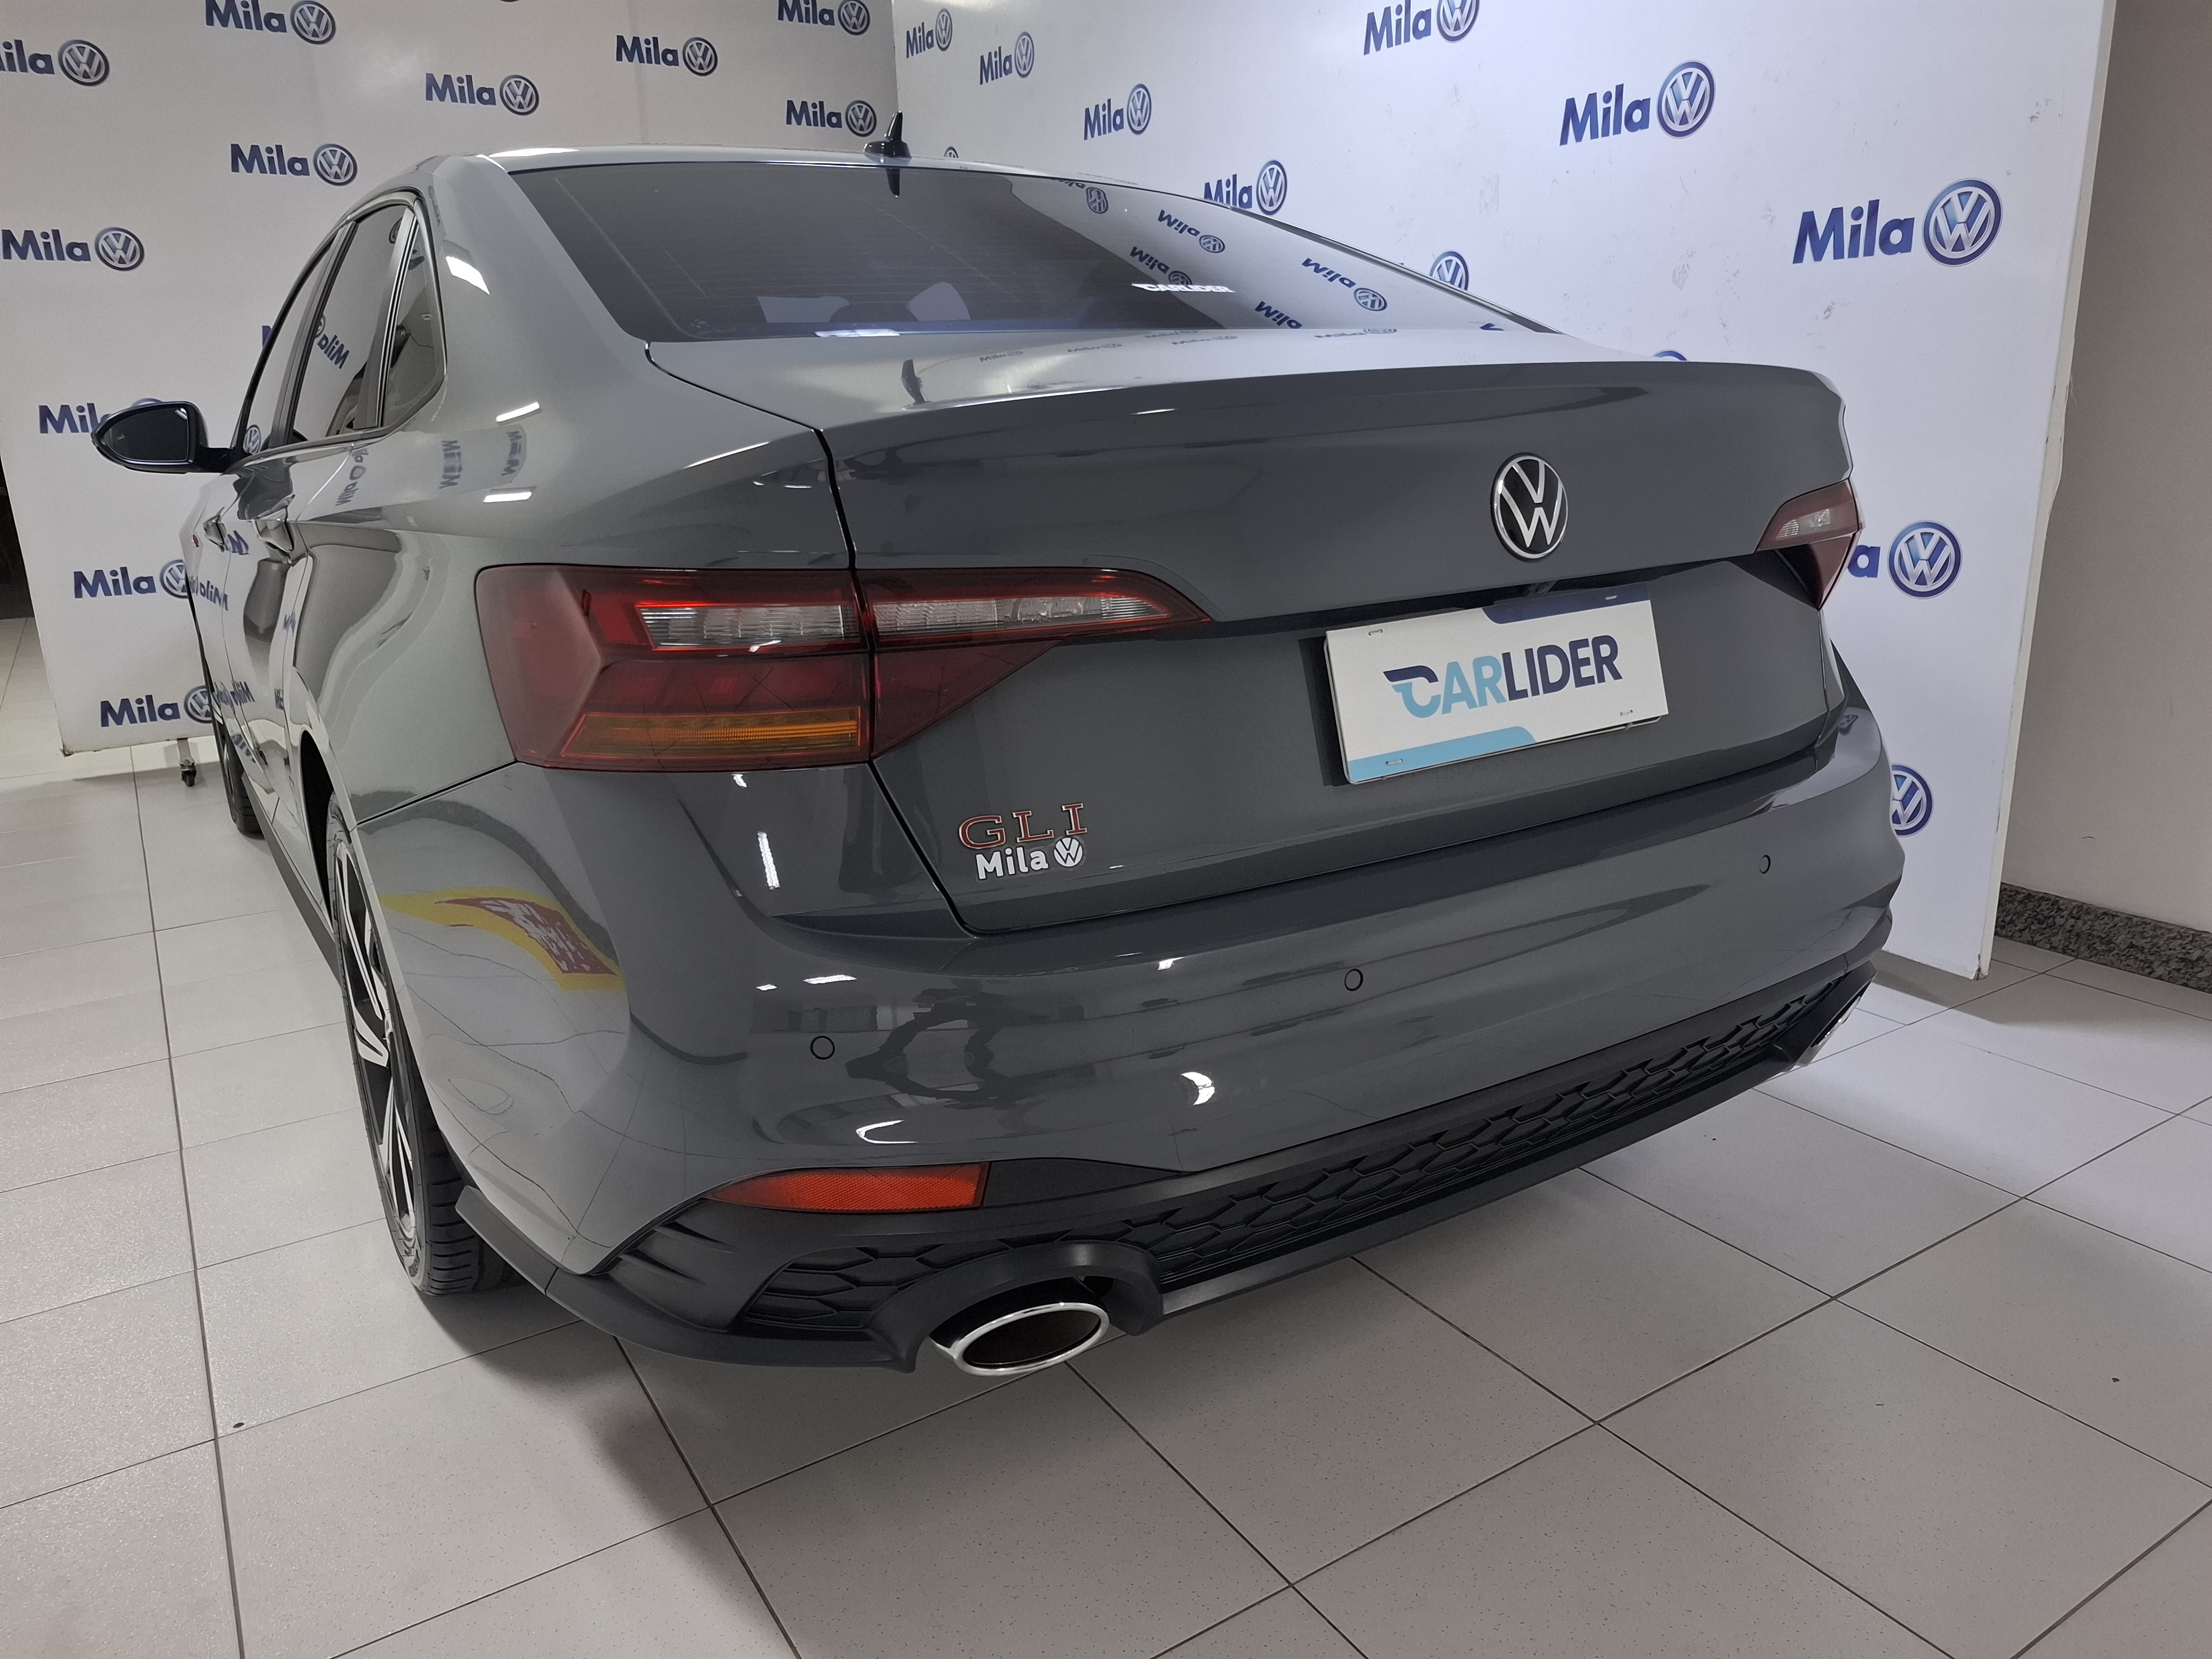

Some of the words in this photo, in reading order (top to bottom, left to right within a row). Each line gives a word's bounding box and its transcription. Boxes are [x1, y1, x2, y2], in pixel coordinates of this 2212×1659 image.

[205, 0, 287, 33] Mila
[778, 0, 835, 25] Mila
[1364, 0, 1431, 55] Mila
[616, 35, 679, 66] Mila
[906, 22, 934, 58] Mila
[0, 40, 54, 74] ila
[980, 47, 1012, 85] Mila
[426, 73, 496, 106] Mila
[786, 100, 842, 128] Mila
[1084, 99, 1124, 140] Mila
[1560, 83, 1650, 146] Mila
[230, 144, 310, 176] Mila
[1204, 173, 1252, 209] Mila
[2, 229, 91, 262] Mila
[1792, 199, 1915, 264] Mila
[1131, 283, 1236, 293] CARLIDER
[38, 403, 112, 434] Mil
[74, 567, 156, 599] Mila
[1382, 635, 1623, 718] CARLIDER
[100, 695, 181, 727] Mila
[959, 802, 1087, 849] GLI
[976, 847, 1049, 879] Mila
